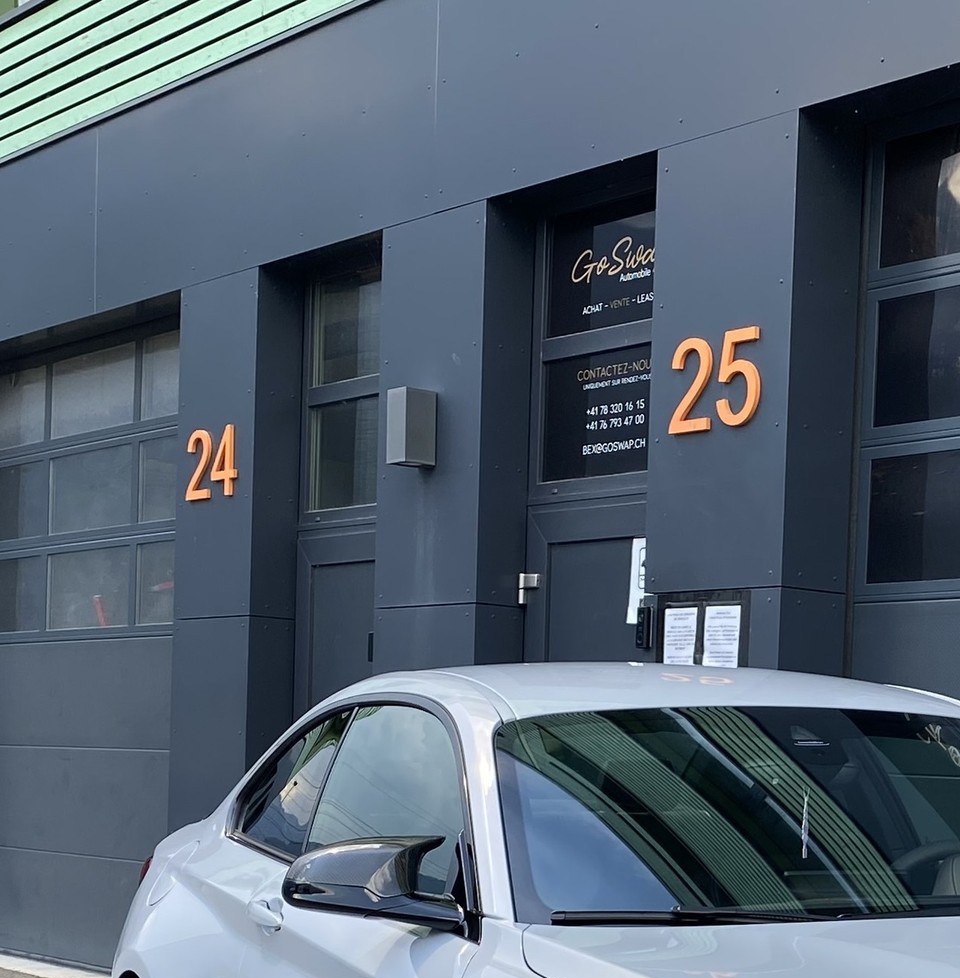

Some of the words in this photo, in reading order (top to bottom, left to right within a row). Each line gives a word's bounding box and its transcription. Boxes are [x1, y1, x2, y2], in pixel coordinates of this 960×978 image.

[571, 236, 656, 283] GoSwa
[619, 267, 651, 282] Automobile
[582, 303, 603, 315] ACHAT
[609, 297, 630, 309] VENTE
[637, 292, 654, 304] LEAS
[577, 359, 651, 382] CONTACTEZ-NOU
[668, 325, 761, 435] 25
[586, 406, 598, 416] +41
[600, 405, 609, 415] 78
[609, 402, 623, 414] 320
[625, 401, 634, 412] 16
[636, 398, 645, 409] 15
[585, 420, 598, 431] +41
[599, 419, 608, 430] 76
[609, 417, 622, 429] 793
[623, 415, 633, 426] 47
[635, 413, 645, 425] 00
[582, 437, 646, 456] BEX@GOSWAP.CH
[185, 424, 238, 501] 24
